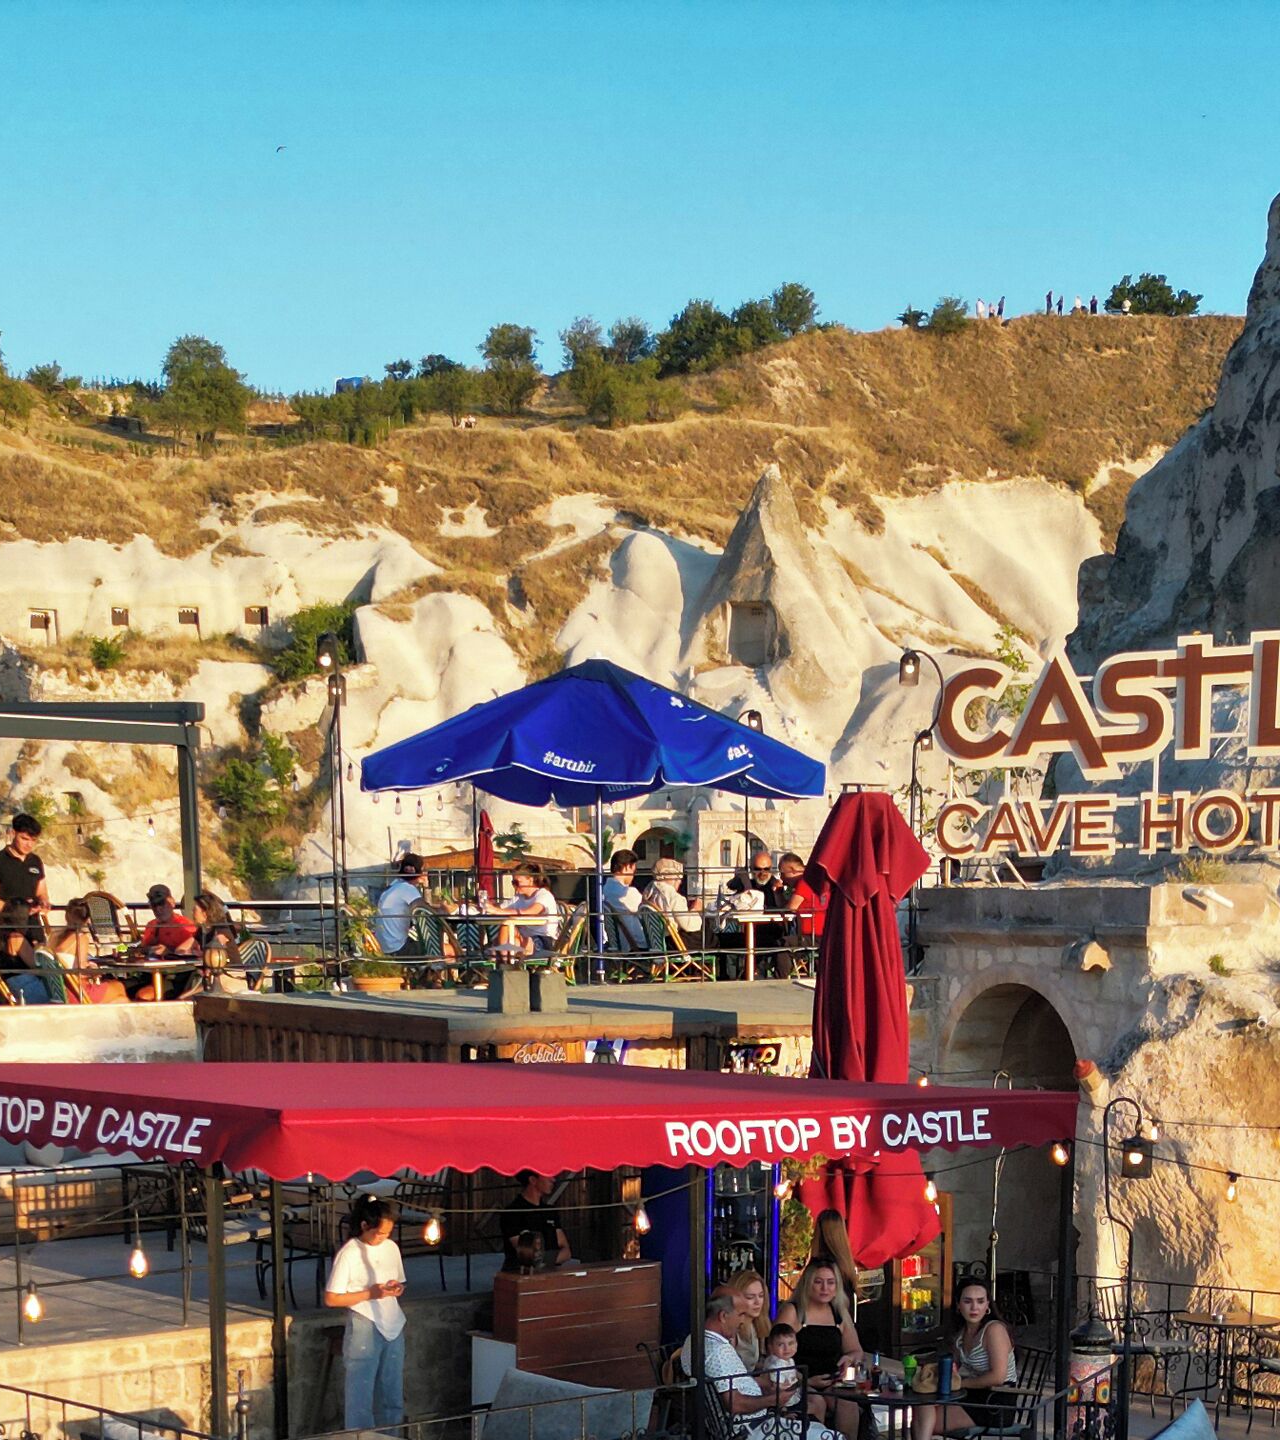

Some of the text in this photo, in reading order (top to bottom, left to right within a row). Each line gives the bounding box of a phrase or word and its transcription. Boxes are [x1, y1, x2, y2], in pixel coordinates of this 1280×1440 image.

[936, 796, 1115, 857] CAVE
[51, 1101, 91, 1140] BY
[96, 1107, 212, 1154] CASTLE
[665, 1108, 992, 1156] ROOFTOP BY CASTLE
